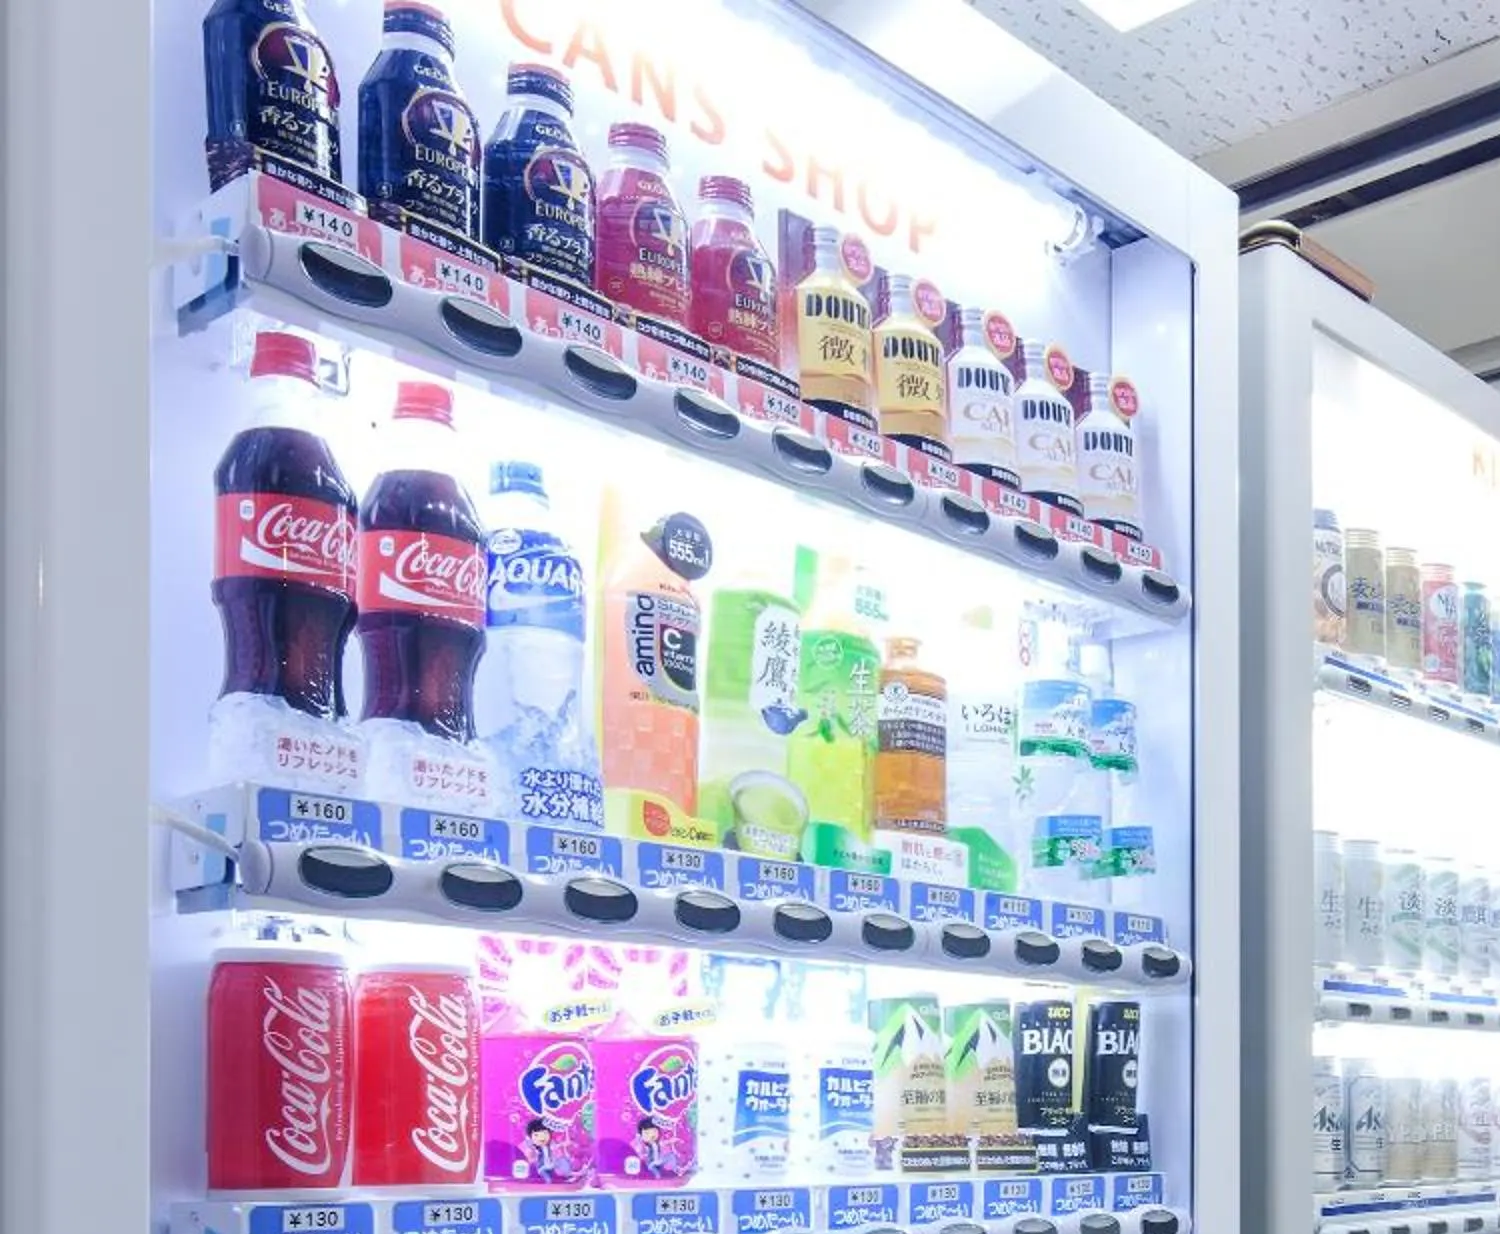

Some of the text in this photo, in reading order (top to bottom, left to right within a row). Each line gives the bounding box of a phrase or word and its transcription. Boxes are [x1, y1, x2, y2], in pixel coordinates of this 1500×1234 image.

[303, 205, 353, 237] ¥140
[441, 262, 484, 292] ¥140
[561, 311, 602, 341] ¥140
[671, 357, 708, 382] ¥140
[631, 593, 655, 677] amino
[278, 752, 359, 780] リフレッシュ
[413, 774, 488, 798] リフレッシュ
[295, 798, 346, 820] ¥160
[434, 817, 480, 838] ¥160
[557, 837, 597, 855] ¥160
[665, 854, 702, 868] ¥130
[1022, 1028, 1074, 1056] BLAC
[262, 974, 332, 1175] Coca-Cola
[407, 983, 469, 1173] Coca-Cola
[521, 1062, 594, 1115] Fant
[632, 1062, 698, 1114] Fant
[550, 1202, 592, 1218] ¥130
[659, 1198, 696, 1213] ¥130
[758, 1194, 792, 1208] ¥130
[289, 1210, 339, 1228] ¥130
[429, 1205, 474, 1223] ¥130
